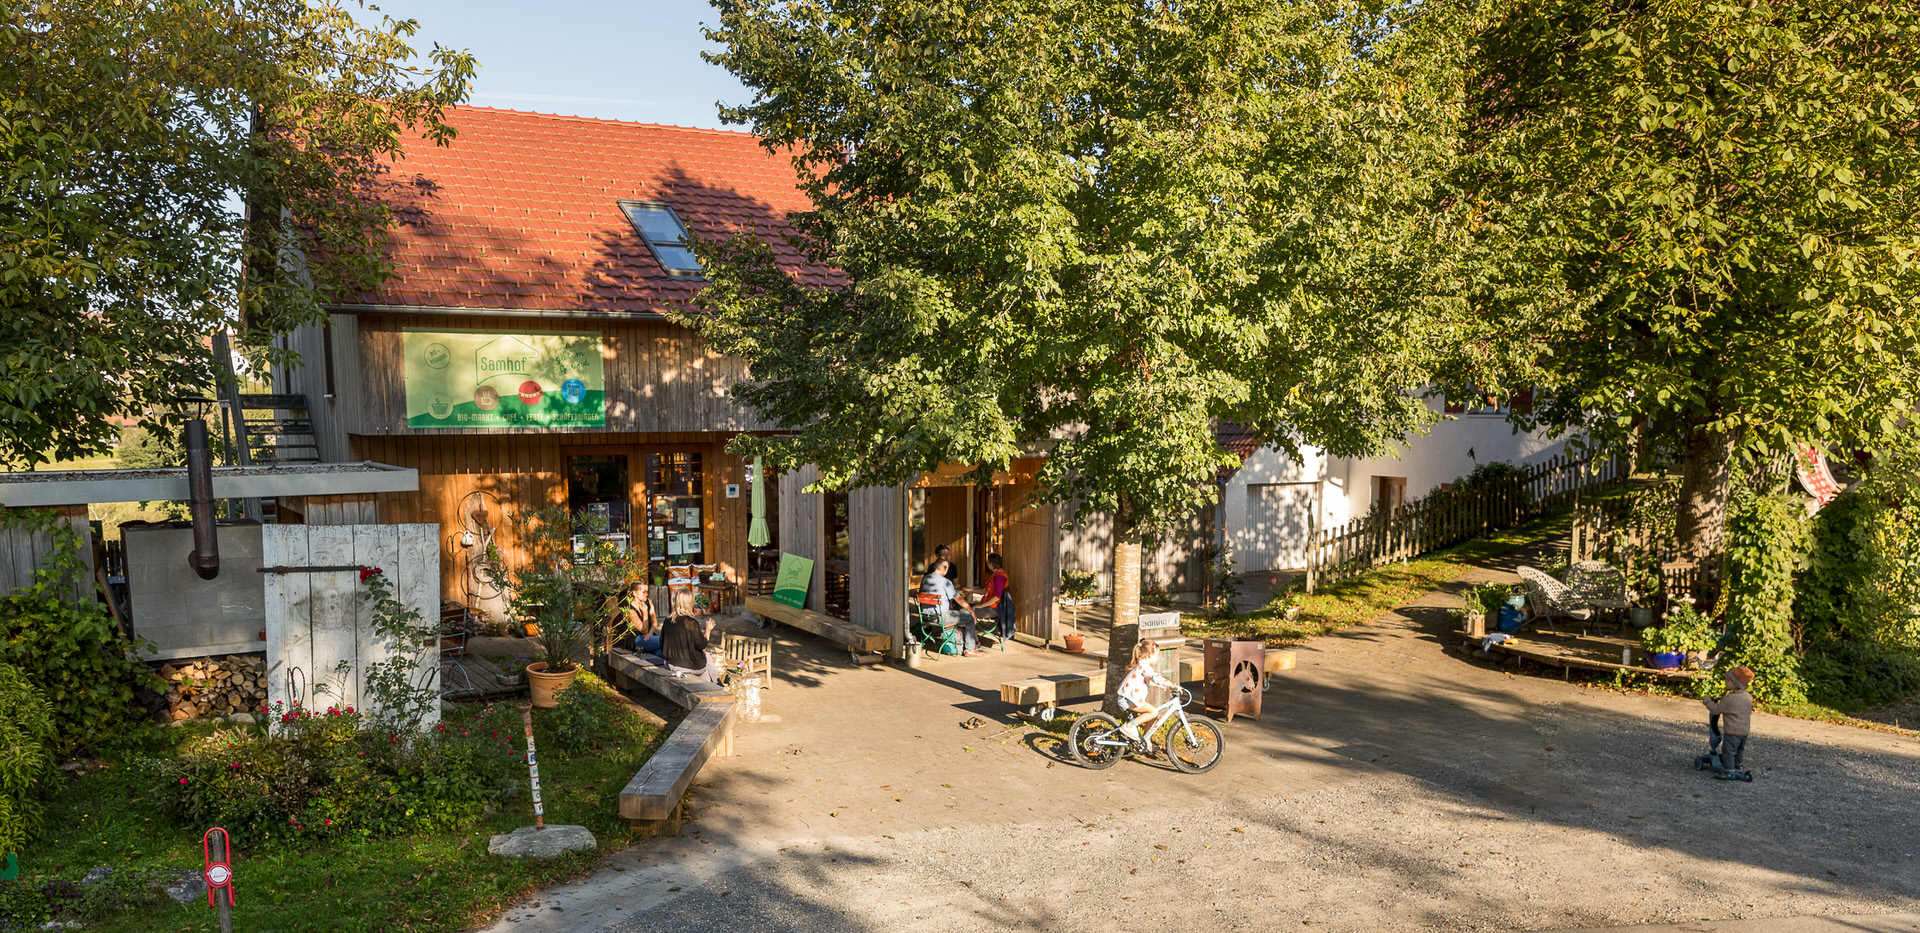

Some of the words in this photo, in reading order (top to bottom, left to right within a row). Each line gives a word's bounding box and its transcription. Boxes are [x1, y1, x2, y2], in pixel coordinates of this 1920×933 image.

[480, 356, 528, 371] Samhof
[457, 413, 494, 422] BIO-MARKT
[502, 412, 518, 422] CAFÉ
[526, 413, 544, 421] FESTE
